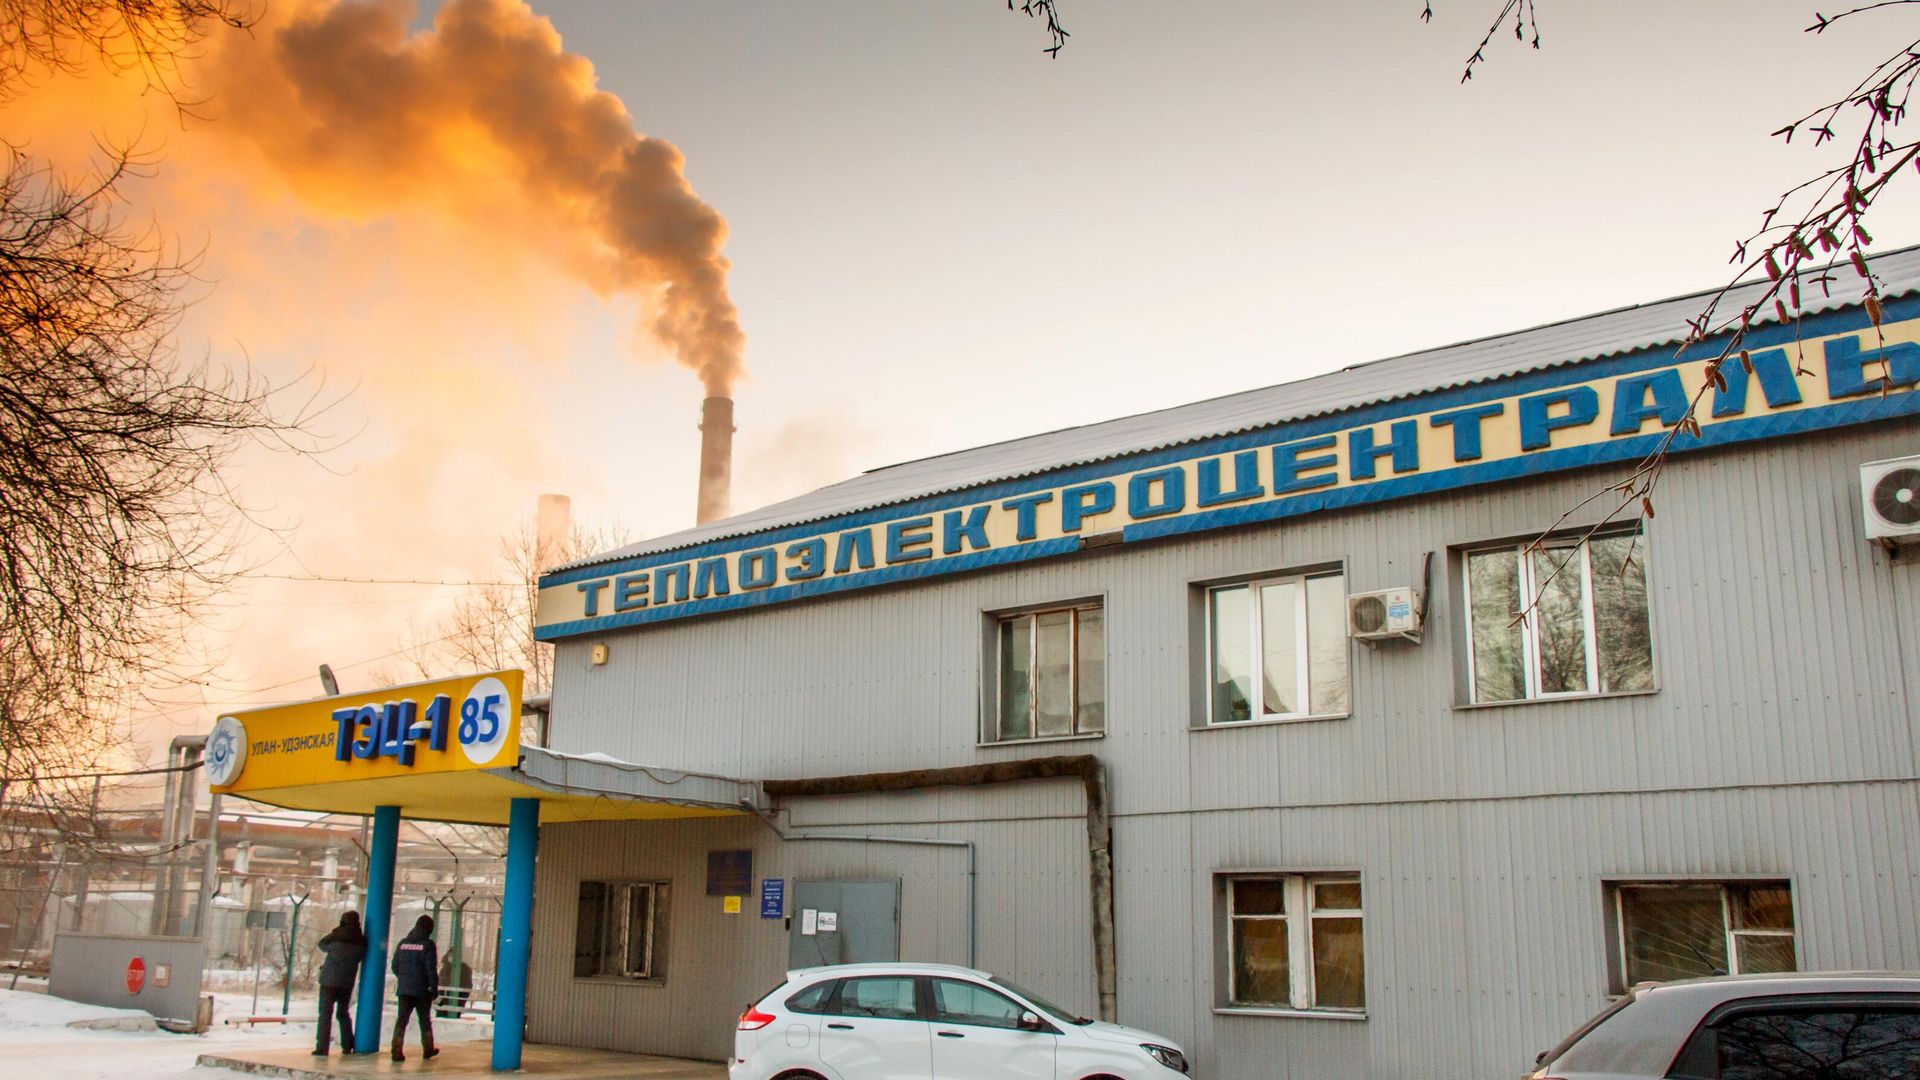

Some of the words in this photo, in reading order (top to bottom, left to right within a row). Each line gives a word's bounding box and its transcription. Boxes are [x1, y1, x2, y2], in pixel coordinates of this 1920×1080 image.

[577, 334, 1920, 617] ТЕПЛОЭЛЕКТРОЦЕНТРАЛЬ
[252, 732, 335, 756] УЛАН-УДЭНСКАЯ
[332, 694, 451, 767] ТЭЦ-1
[458, 694, 501, 746] 85
